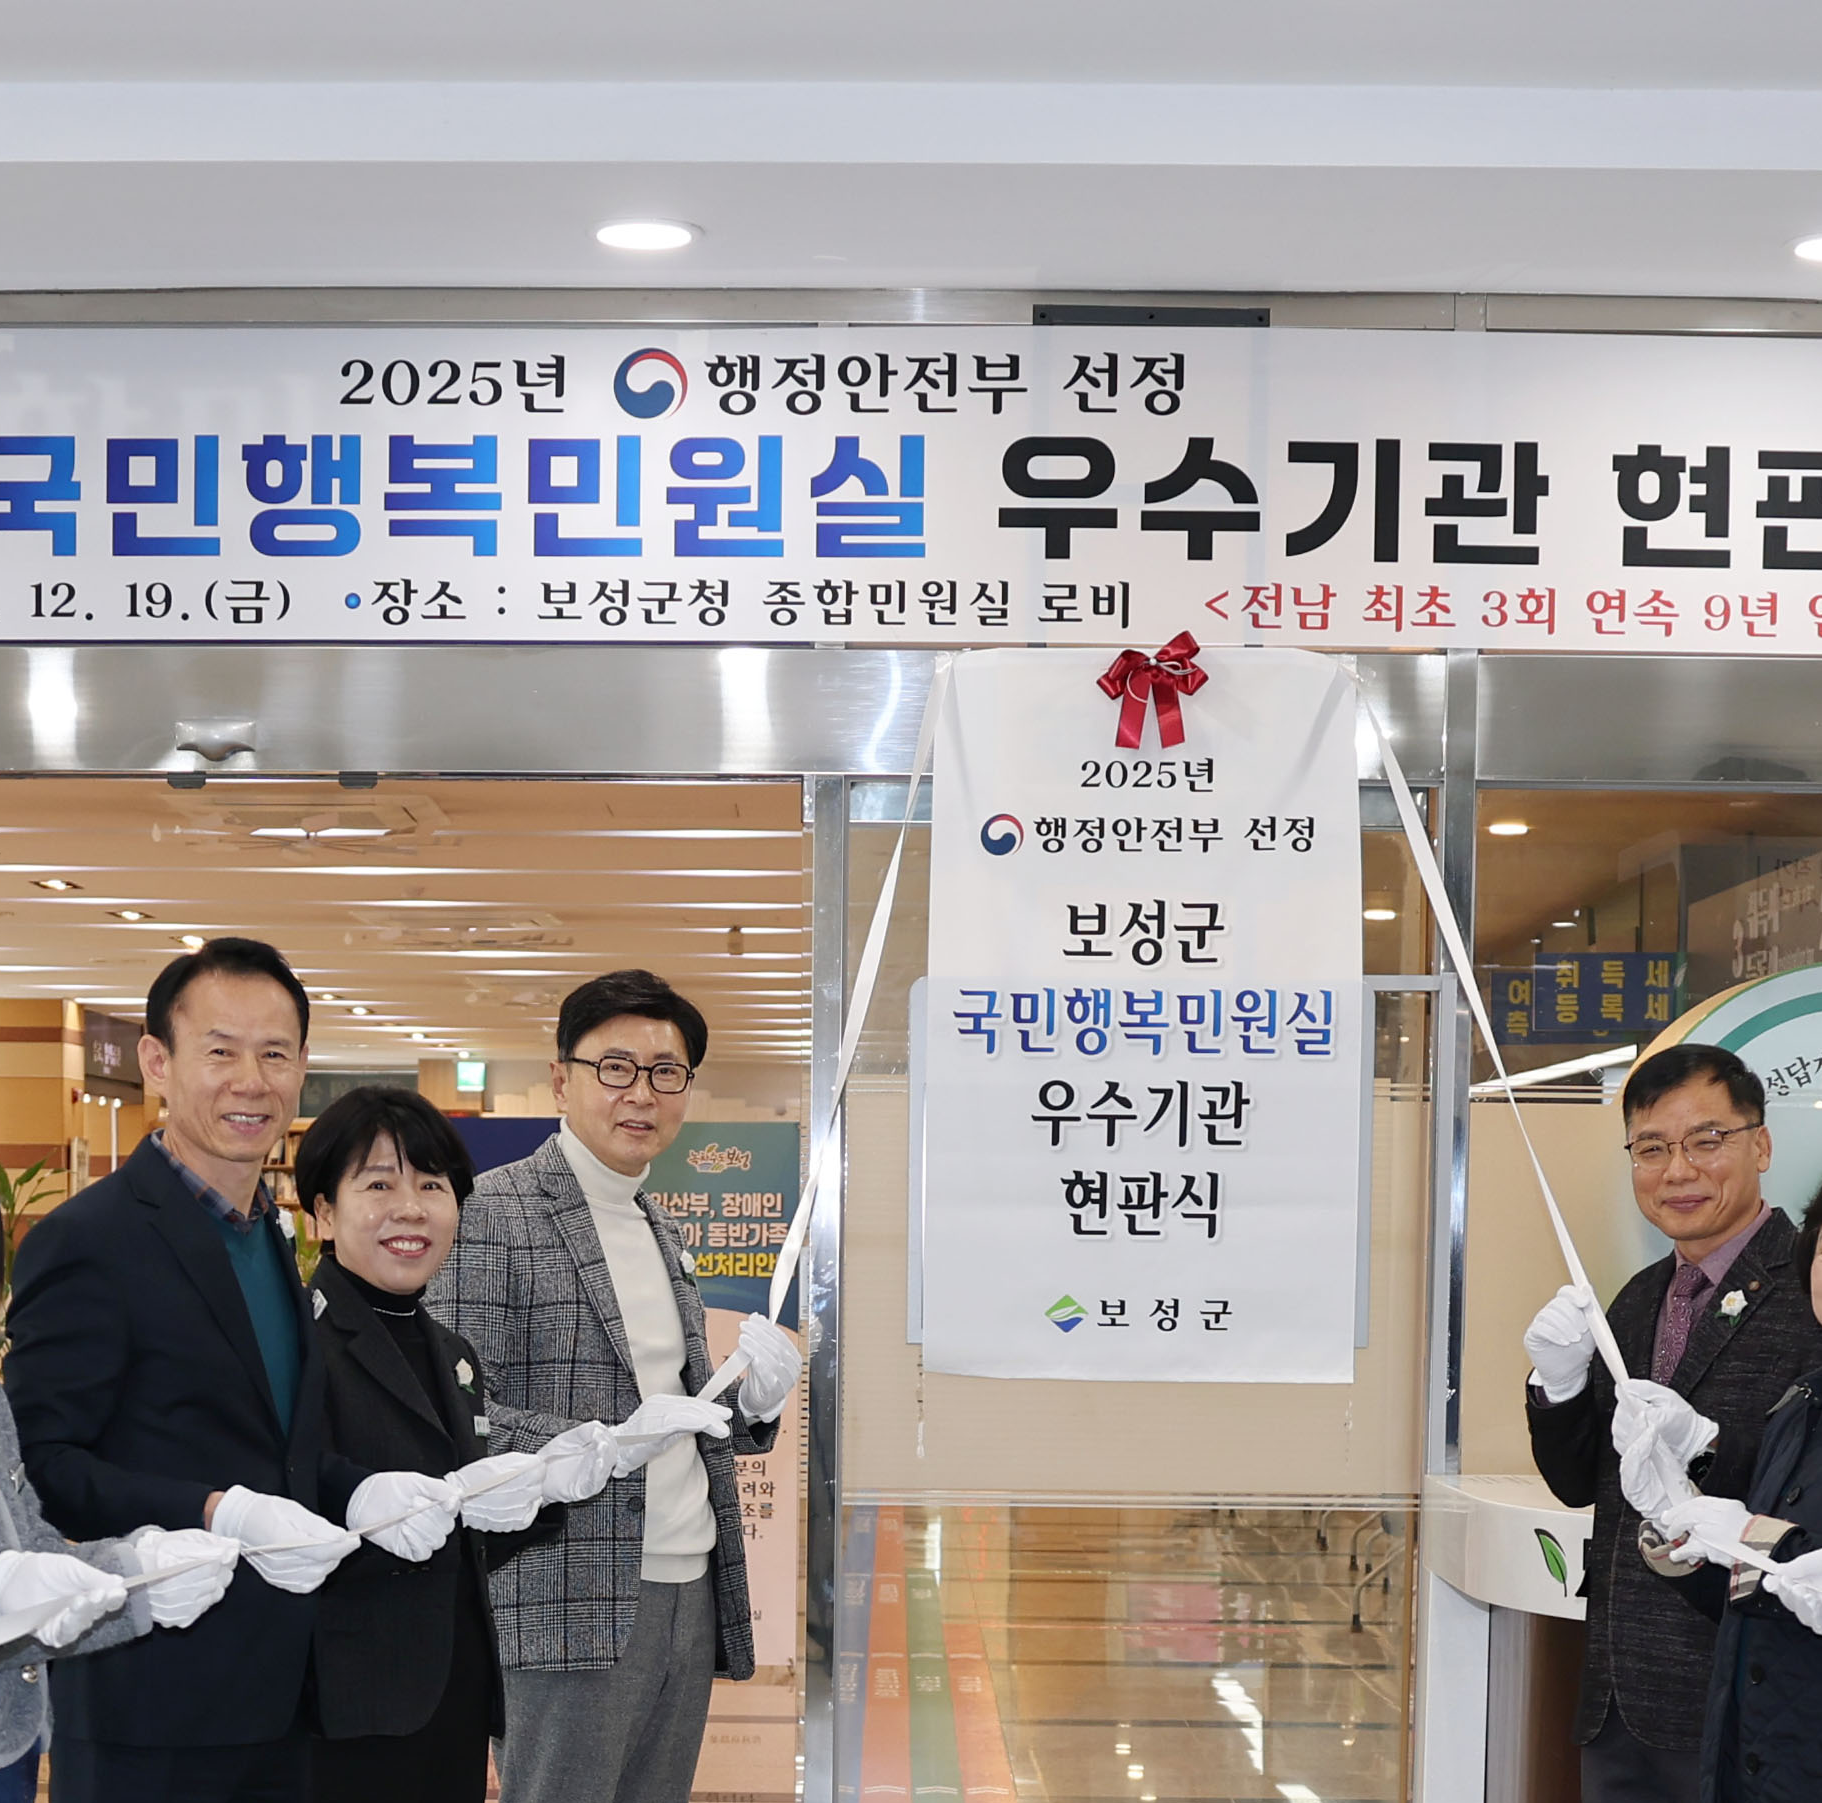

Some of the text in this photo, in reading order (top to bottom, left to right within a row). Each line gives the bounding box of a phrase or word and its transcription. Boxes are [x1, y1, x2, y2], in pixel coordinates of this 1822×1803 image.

[339, 351, 1186, 416] 2025년 행정안전부 선정
[998, 436, 1550, 566] 우수기관
[30, 582, 94, 622] 12.
[125, 580, 292, 624] 19.(금)
[371, 579, 466, 626] 장소
[537, 579, 732, 626] 보성군청
[762, 579, 1011, 627] 종합민원실
[1038, 580, 1131, 628] 로비
[1204, 582, 1338, 632] <전남
[1363, 584, 1457, 631] 최초
[1482, 586, 1557, 635] 3회
[1585, 588, 1681, 637] 연속
[1703, 591, 1780, 638] 9년
[1080, 757, 1216, 793] 2025년
[1033, 815, 1316, 853] 행정안전부 선정
[1062, 900, 1227, 966] 보성군
[953, 987, 1334, 1057] 국민행복민원실
[1031, 1079, 1252, 1148] 우수기관
[722, 1193, 783, 1218] 장애인
[1060, 1170, 1221, 1239] 현판식
[1097, 1298, 1233, 1333] 보성군
